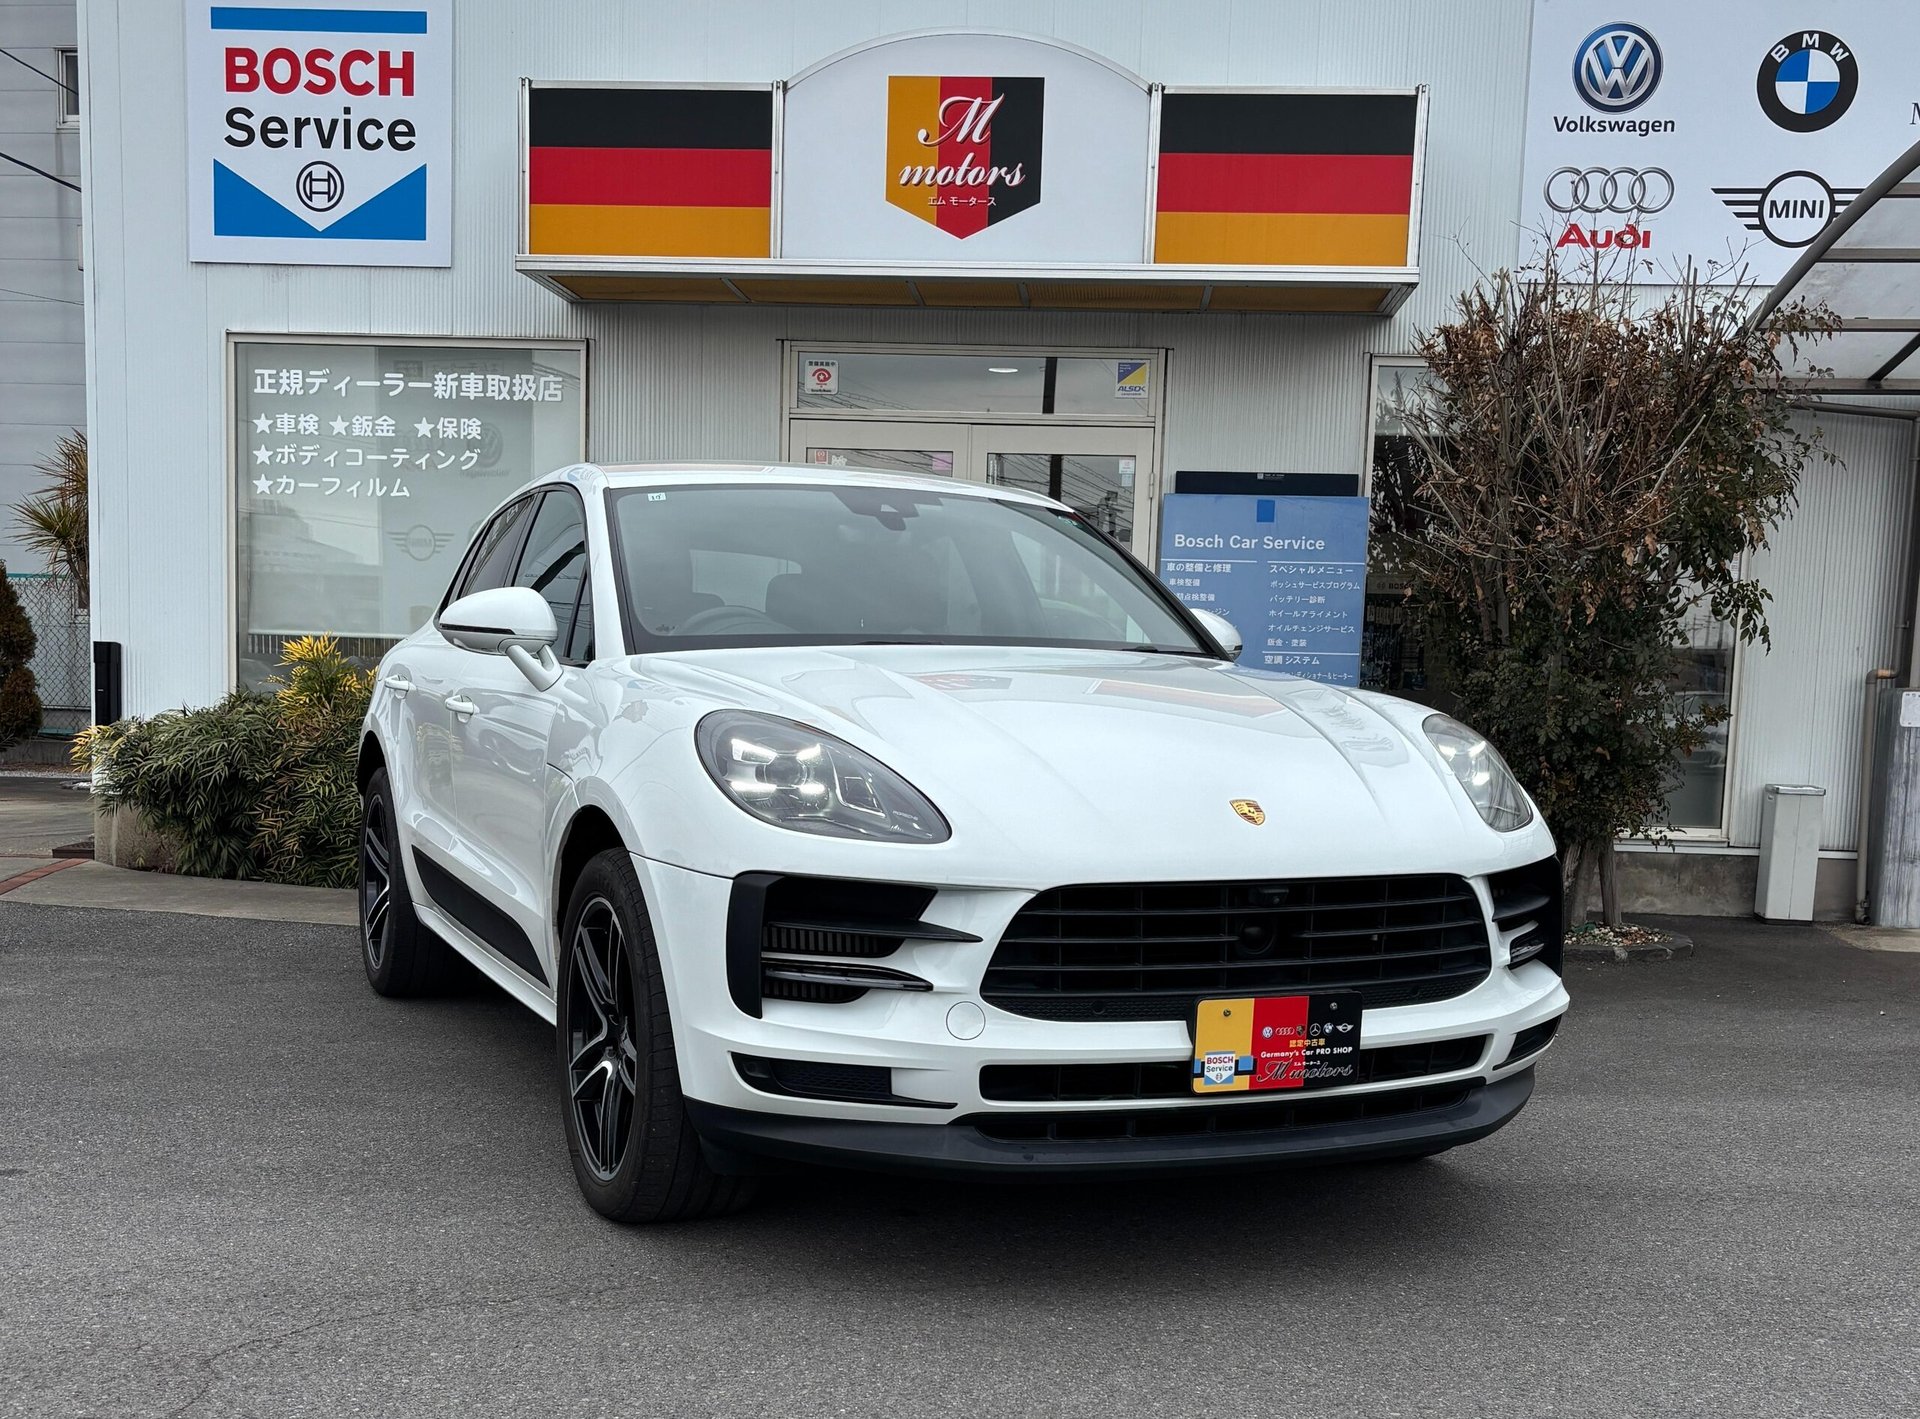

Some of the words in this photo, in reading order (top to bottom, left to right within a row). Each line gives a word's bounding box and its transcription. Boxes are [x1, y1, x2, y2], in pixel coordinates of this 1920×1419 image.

[1770, 33, 1849, 63] BMW
[225, 47, 415, 97] BOSCH
[224, 106, 416, 151] Service
[917, 93, 1005, 147] M
[1553, 115, 1676, 137] Volkswagen
[899, 152, 1027, 188] motors
[928, 196, 946, 207] エム
[949, 196, 997, 207] モータース
[1768, 199, 1825, 219] MINI
[1556, 223, 1652, 249] Audi
[253, 367, 564, 403] 正規ディーラー新車取扱店
[275, 413, 320, 436] 車検
[351, 414, 396, 438] 鈑金
[437, 417, 482, 440] 保険
[276, 444, 481, 471] ボディコーティング
[276, 474, 410, 498] カーフィルム
[1174, 534, 1224, 549] Bosch
[1229, 535, 1258, 549] Car
[1263, 536, 1325, 550] Service
[1166, 562, 1231, 573] 車の整備と修理
[1269, 564, 1354, 575] スペシャルメニュー
[1268, 609, 1348, 619] ホイールアライメント
[1285, 655, 1320, 665] システム
[1206, 1055, 1234, 1065] BOSCH
[1260, 1050, 1299, 1059] Germany's
[1316, 1047, 1331, 1055] PRO
[1333, 1046, 1353, 1054] SHOP
[1206, 1065, 1233, 1073] Service
[1289, 1062, 1354, 1080] motors
